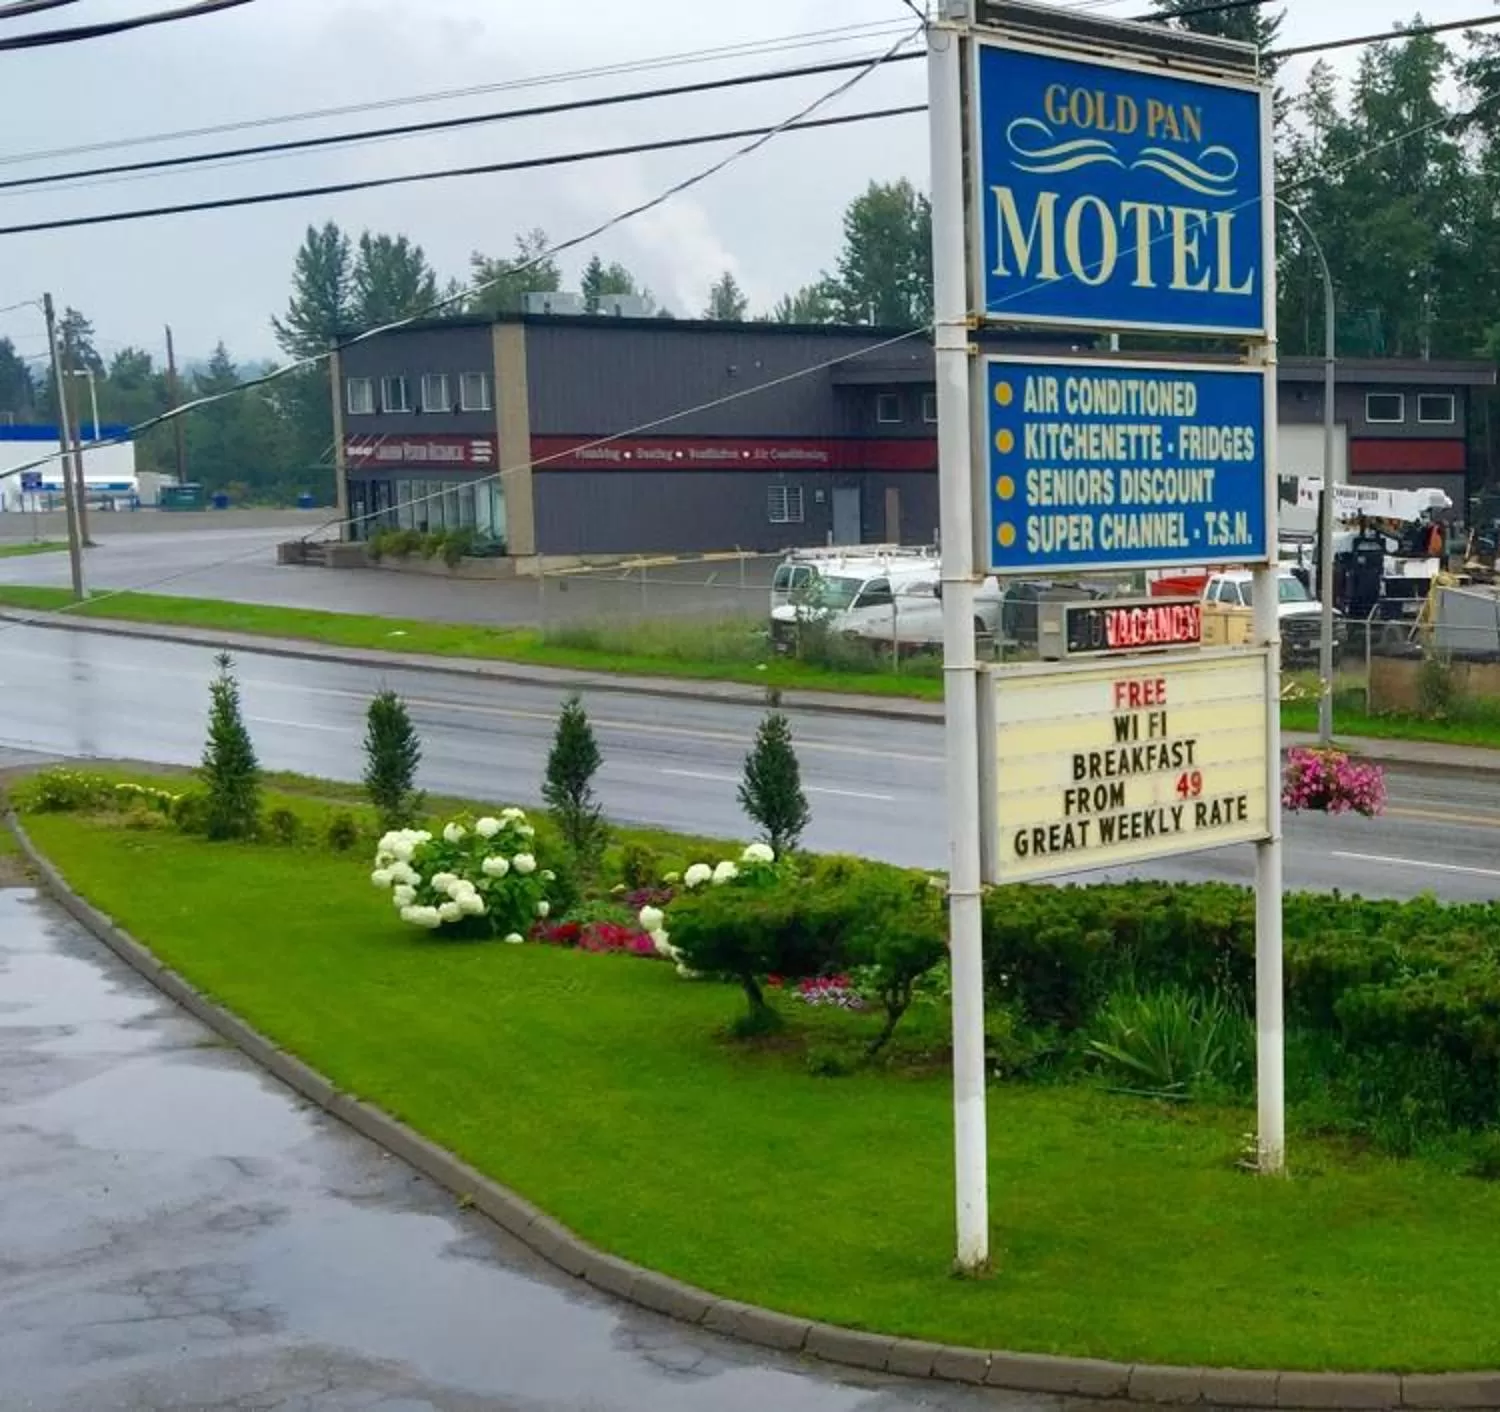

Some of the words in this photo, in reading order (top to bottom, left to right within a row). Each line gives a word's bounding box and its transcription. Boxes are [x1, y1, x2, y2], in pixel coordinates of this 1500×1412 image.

[1043, 84, 1138, 134] GOLD
[1147, 98, 1202, 143] PAN
[990, 185, 1254, 295] MOTEL
[1023, 376, 1059, 413] AIR
[1065, 377, 1197, 417] CONDITIONED
[1024, 423, 1163, 460] KITCHENETTE
[1179, 425, 1255, 460] FRIDGES
[1026, 468, 1114, 506] SENIORS
[1120, 468, 1215, 504] DISCOUNT
[1027, 515, 1094, 553] SUPER
[1100, 512, 1189, 550] CHANNEL
[1204, 511, 1252, 546] T.S.N.
[1105, 604, 1202, 647] VACANCY
[1114, 678, 1167, 708] FREE
[1114, 714, 1138, 742] WI
[1148, 711, 1167, 738] FI
[1073, 740, 1197, 781] BREAKFAST
[1064, 782, 1126, 816] FROM
[1176, 771, 1203, 799] 49
[1014, 820, 1091, 857] GREAT
[1099, 805, 1183, 845] WEEKLY
[1196, 795, 1248, 827] RATE
